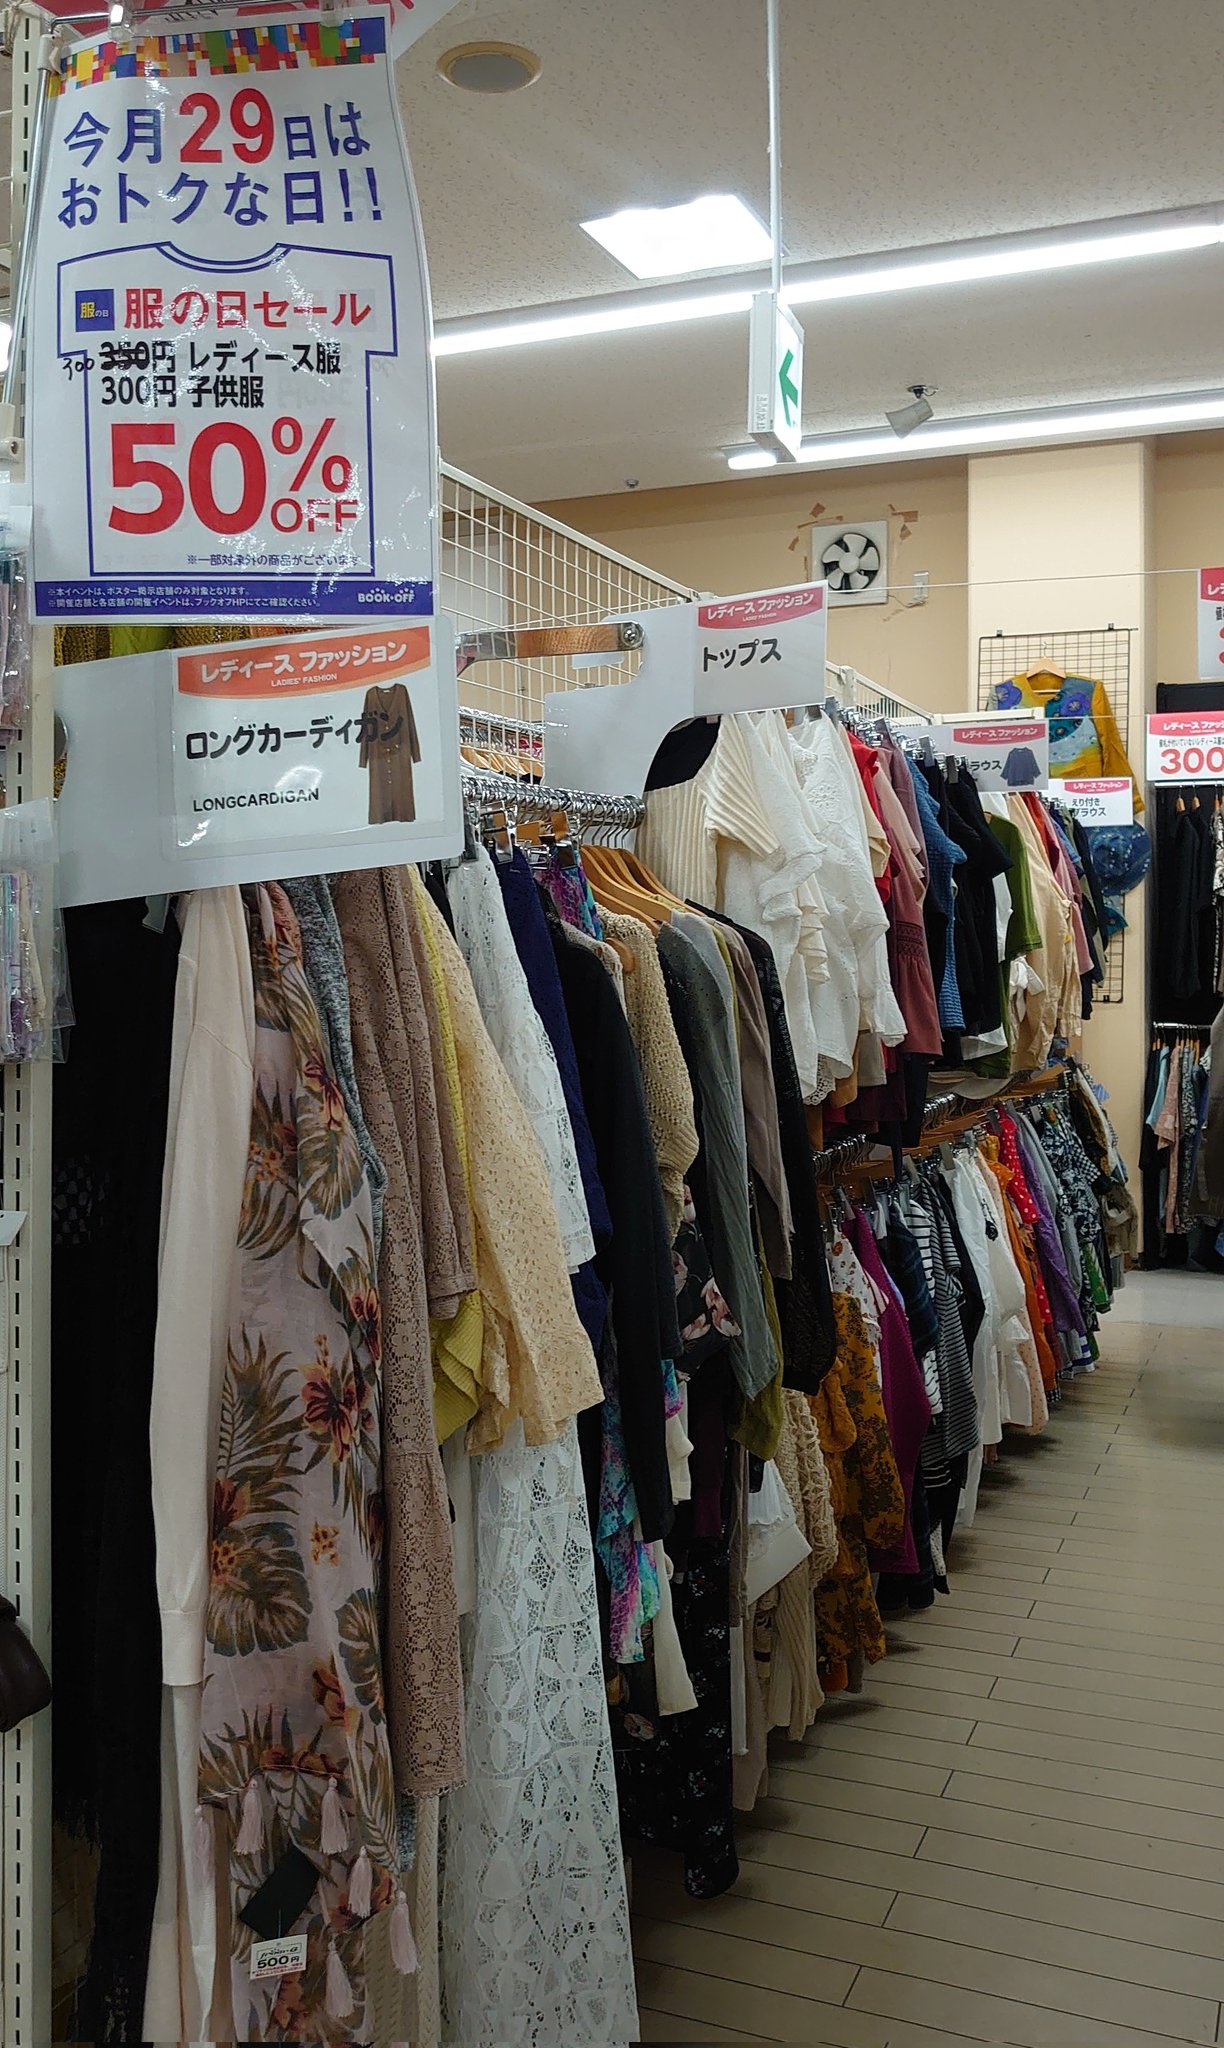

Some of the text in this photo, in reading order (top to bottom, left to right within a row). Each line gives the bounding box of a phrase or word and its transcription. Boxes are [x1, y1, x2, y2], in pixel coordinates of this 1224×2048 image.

[63, 88, 370, 167] 今月29日は
[124, 288, 371, 330] 服の日セール
[190, 340, 342, 375] レディース服
[101, 375, 265, 408] 300円 子供服
[108, 416, 351, 535] 50%
[270, 498, 359, 533] OFF
[707, 592, 814, 621] レディース ファッション
[202, 641, 407, 684] レディース ファッション
[703, 638, 782, 672] トップス
[302, 673, 338, 684] FASHION
[186, 711, 404, 760] ロングカーディガン
[962, 727, 1037, 739] レディース ファッション
[1163, 721, 1200, 731] レディース
[968, 760, 1002, 772] ラウス
[193, 788, 320, 812] LONGCARDIGAN
[1073, 782, 1097, 790] レディース
[257, 1955, 300, 1969] 500円
